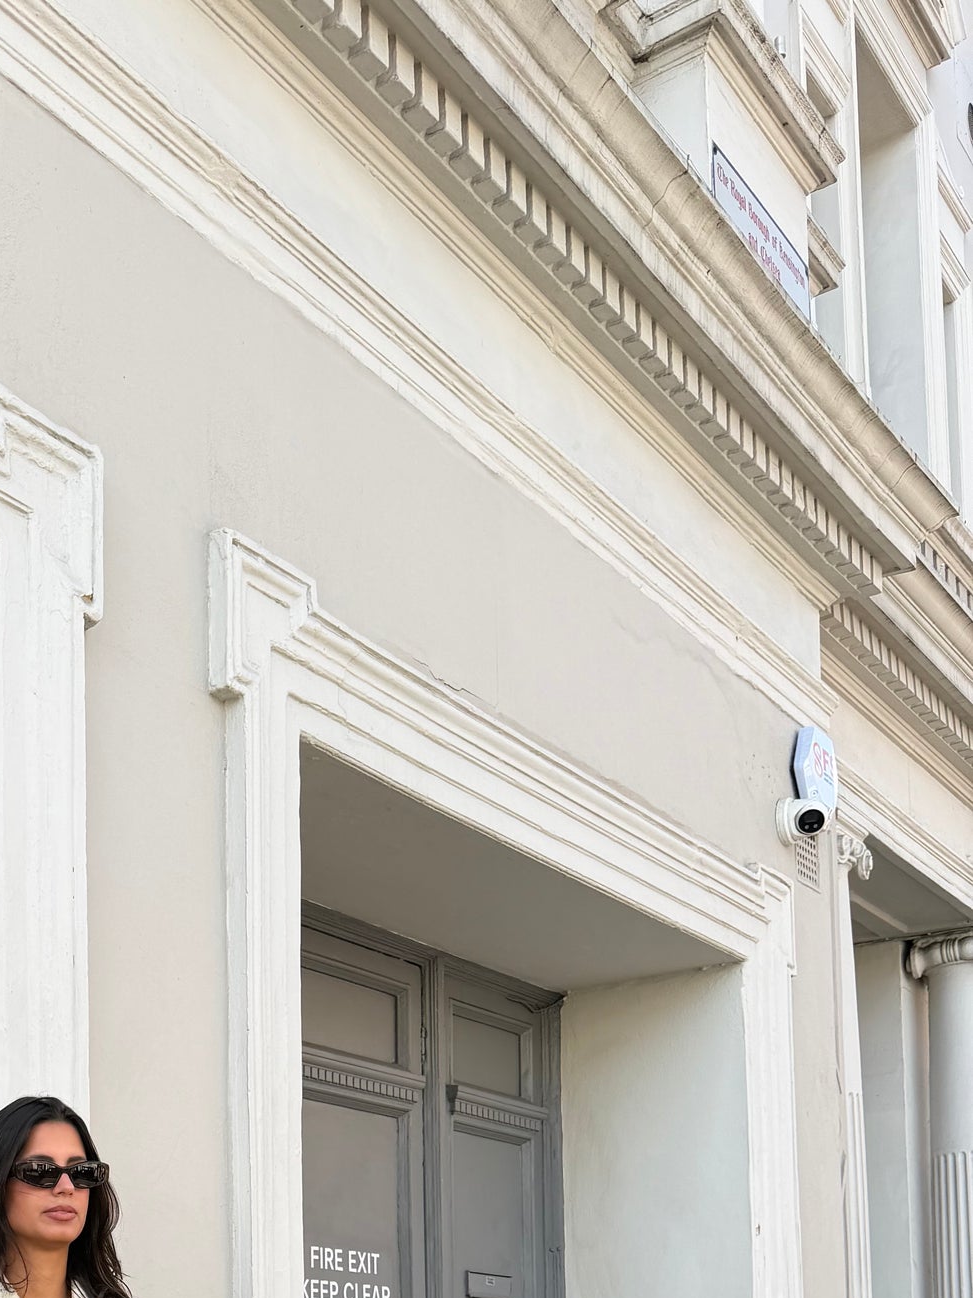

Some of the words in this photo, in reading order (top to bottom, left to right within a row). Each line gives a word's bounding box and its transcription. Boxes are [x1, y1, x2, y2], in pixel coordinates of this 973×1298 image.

[717, 162, 729, 189] The
[730, 178, 746, 211] Royal
[749, 202, 769, 242] Borough
[772, 236, 777, 251] of
[779, 241, 805, 289] Kensington
[748, 232, 758, 254] and
[310, 1245, 344, 1272] FIRE
[348, 1250, 380, 1275] EXIT
